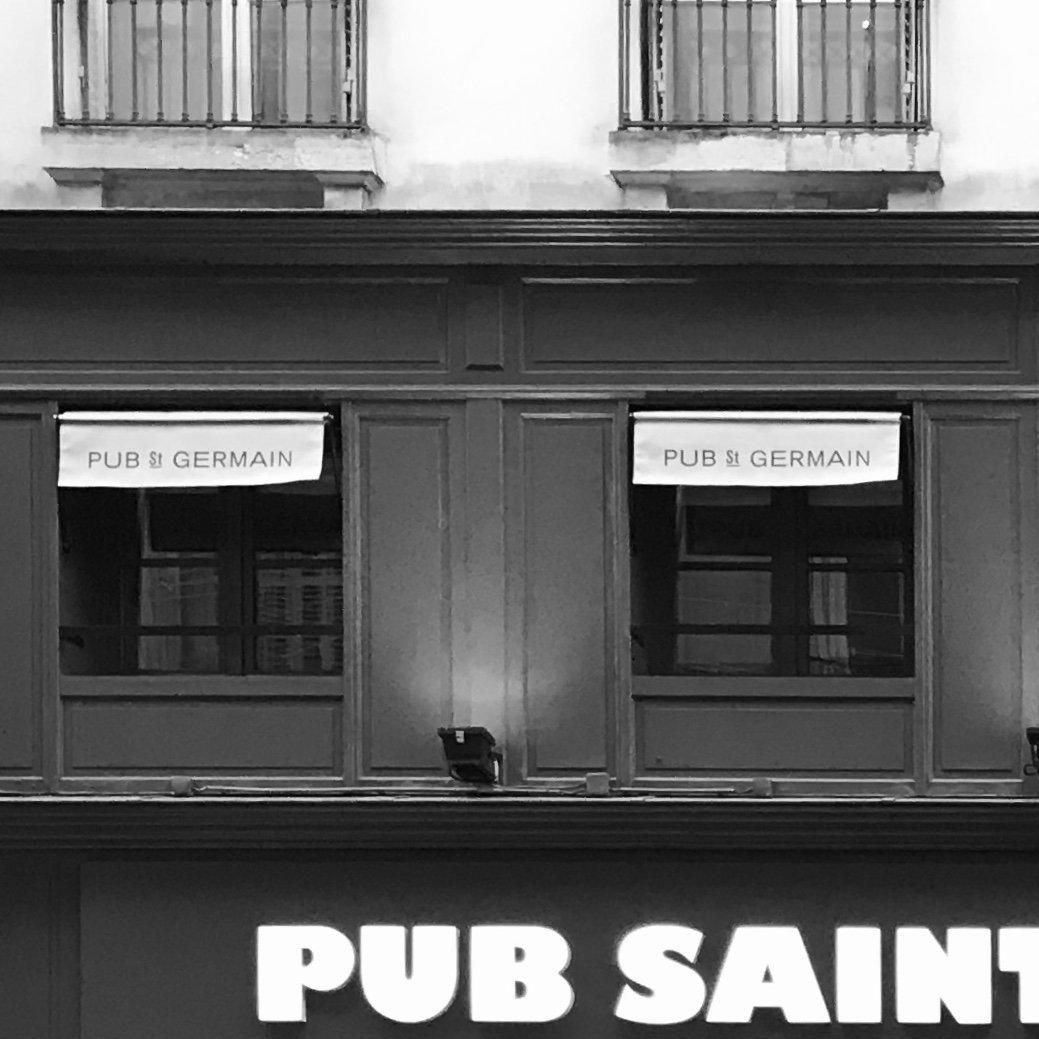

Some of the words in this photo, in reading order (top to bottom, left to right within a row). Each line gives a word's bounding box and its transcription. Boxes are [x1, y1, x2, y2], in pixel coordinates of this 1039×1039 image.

[88, 451, 140, 469] PUB
[172, 450, 293, 469] GERMAIN
[663, 449, 717, 468] PUB
[750, 449, 872, 468] GERMAIN
[256, 924, 575, 1024] PUB
